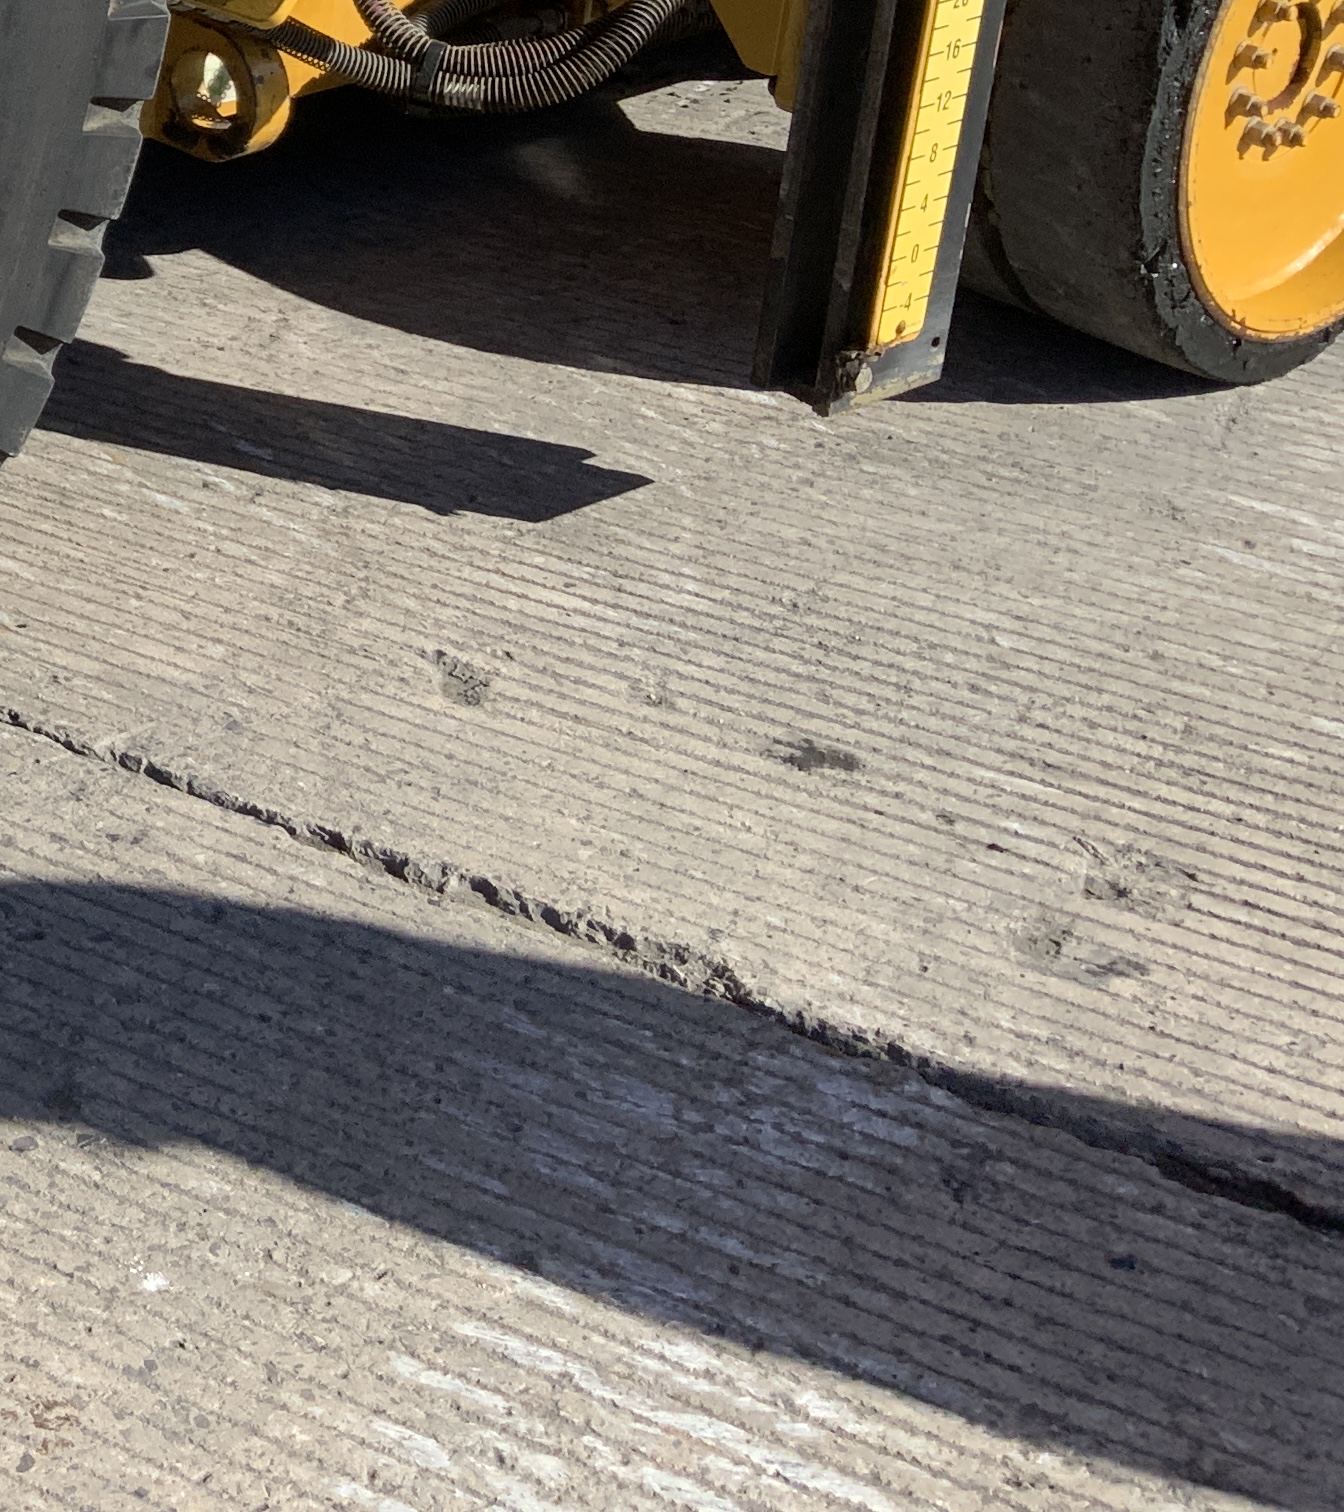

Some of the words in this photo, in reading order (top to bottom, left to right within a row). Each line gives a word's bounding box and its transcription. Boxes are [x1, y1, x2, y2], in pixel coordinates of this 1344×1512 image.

[945, 38, 962, 62] 16
[935, 90, 953, 113] 12
[928, 142, 939, 163] 8
[919, 194, 930, 214] 4
[909, 244, 920, 264] 0
